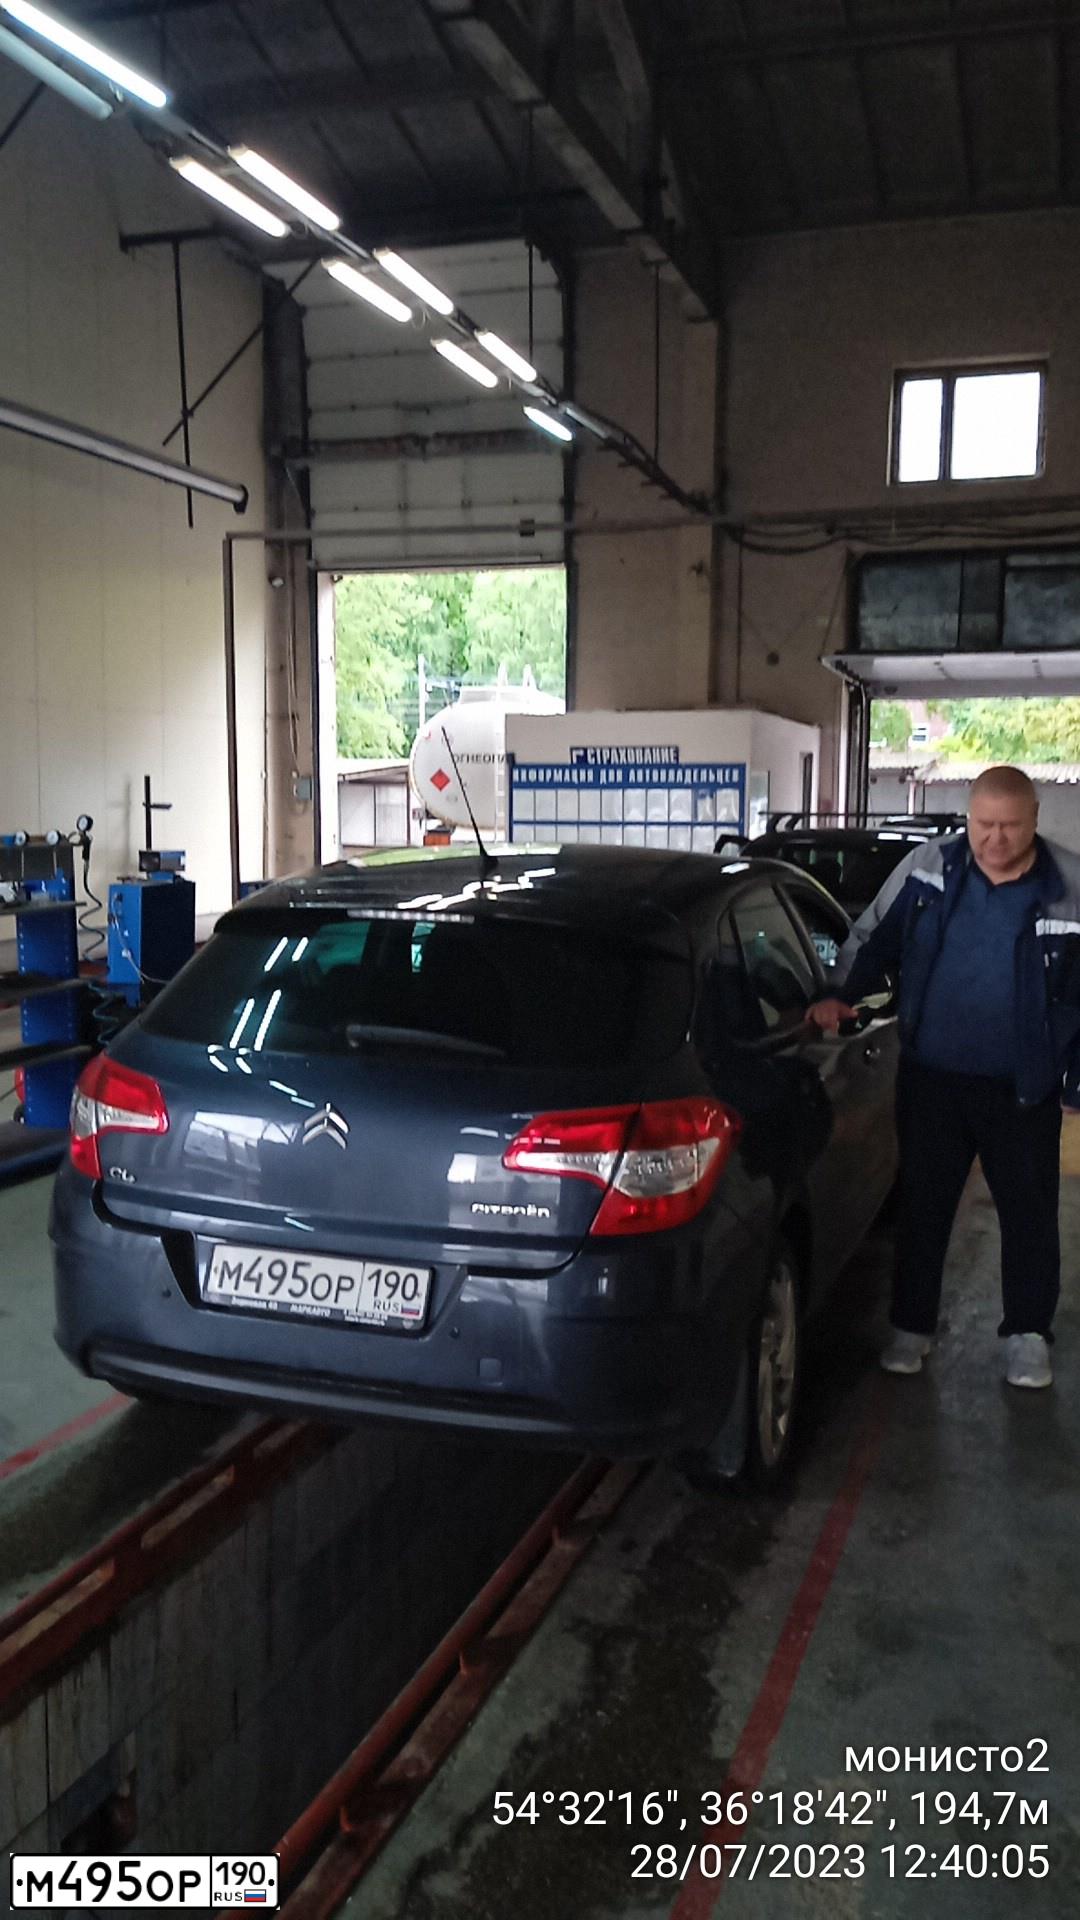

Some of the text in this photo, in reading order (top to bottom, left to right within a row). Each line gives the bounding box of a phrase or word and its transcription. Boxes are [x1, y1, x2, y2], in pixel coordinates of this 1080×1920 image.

[586, 747, 679, 764] СТРАХОВАНИЕ
[513, 768, 739, 784] ИНФОРМАЦИЯ ДЛЯ АВТОВЛАДЕЛЬЦЕВ
[217, 1256, 420, 1303] М495ОР 190
[373, 1299, 400, 1314] RUS
